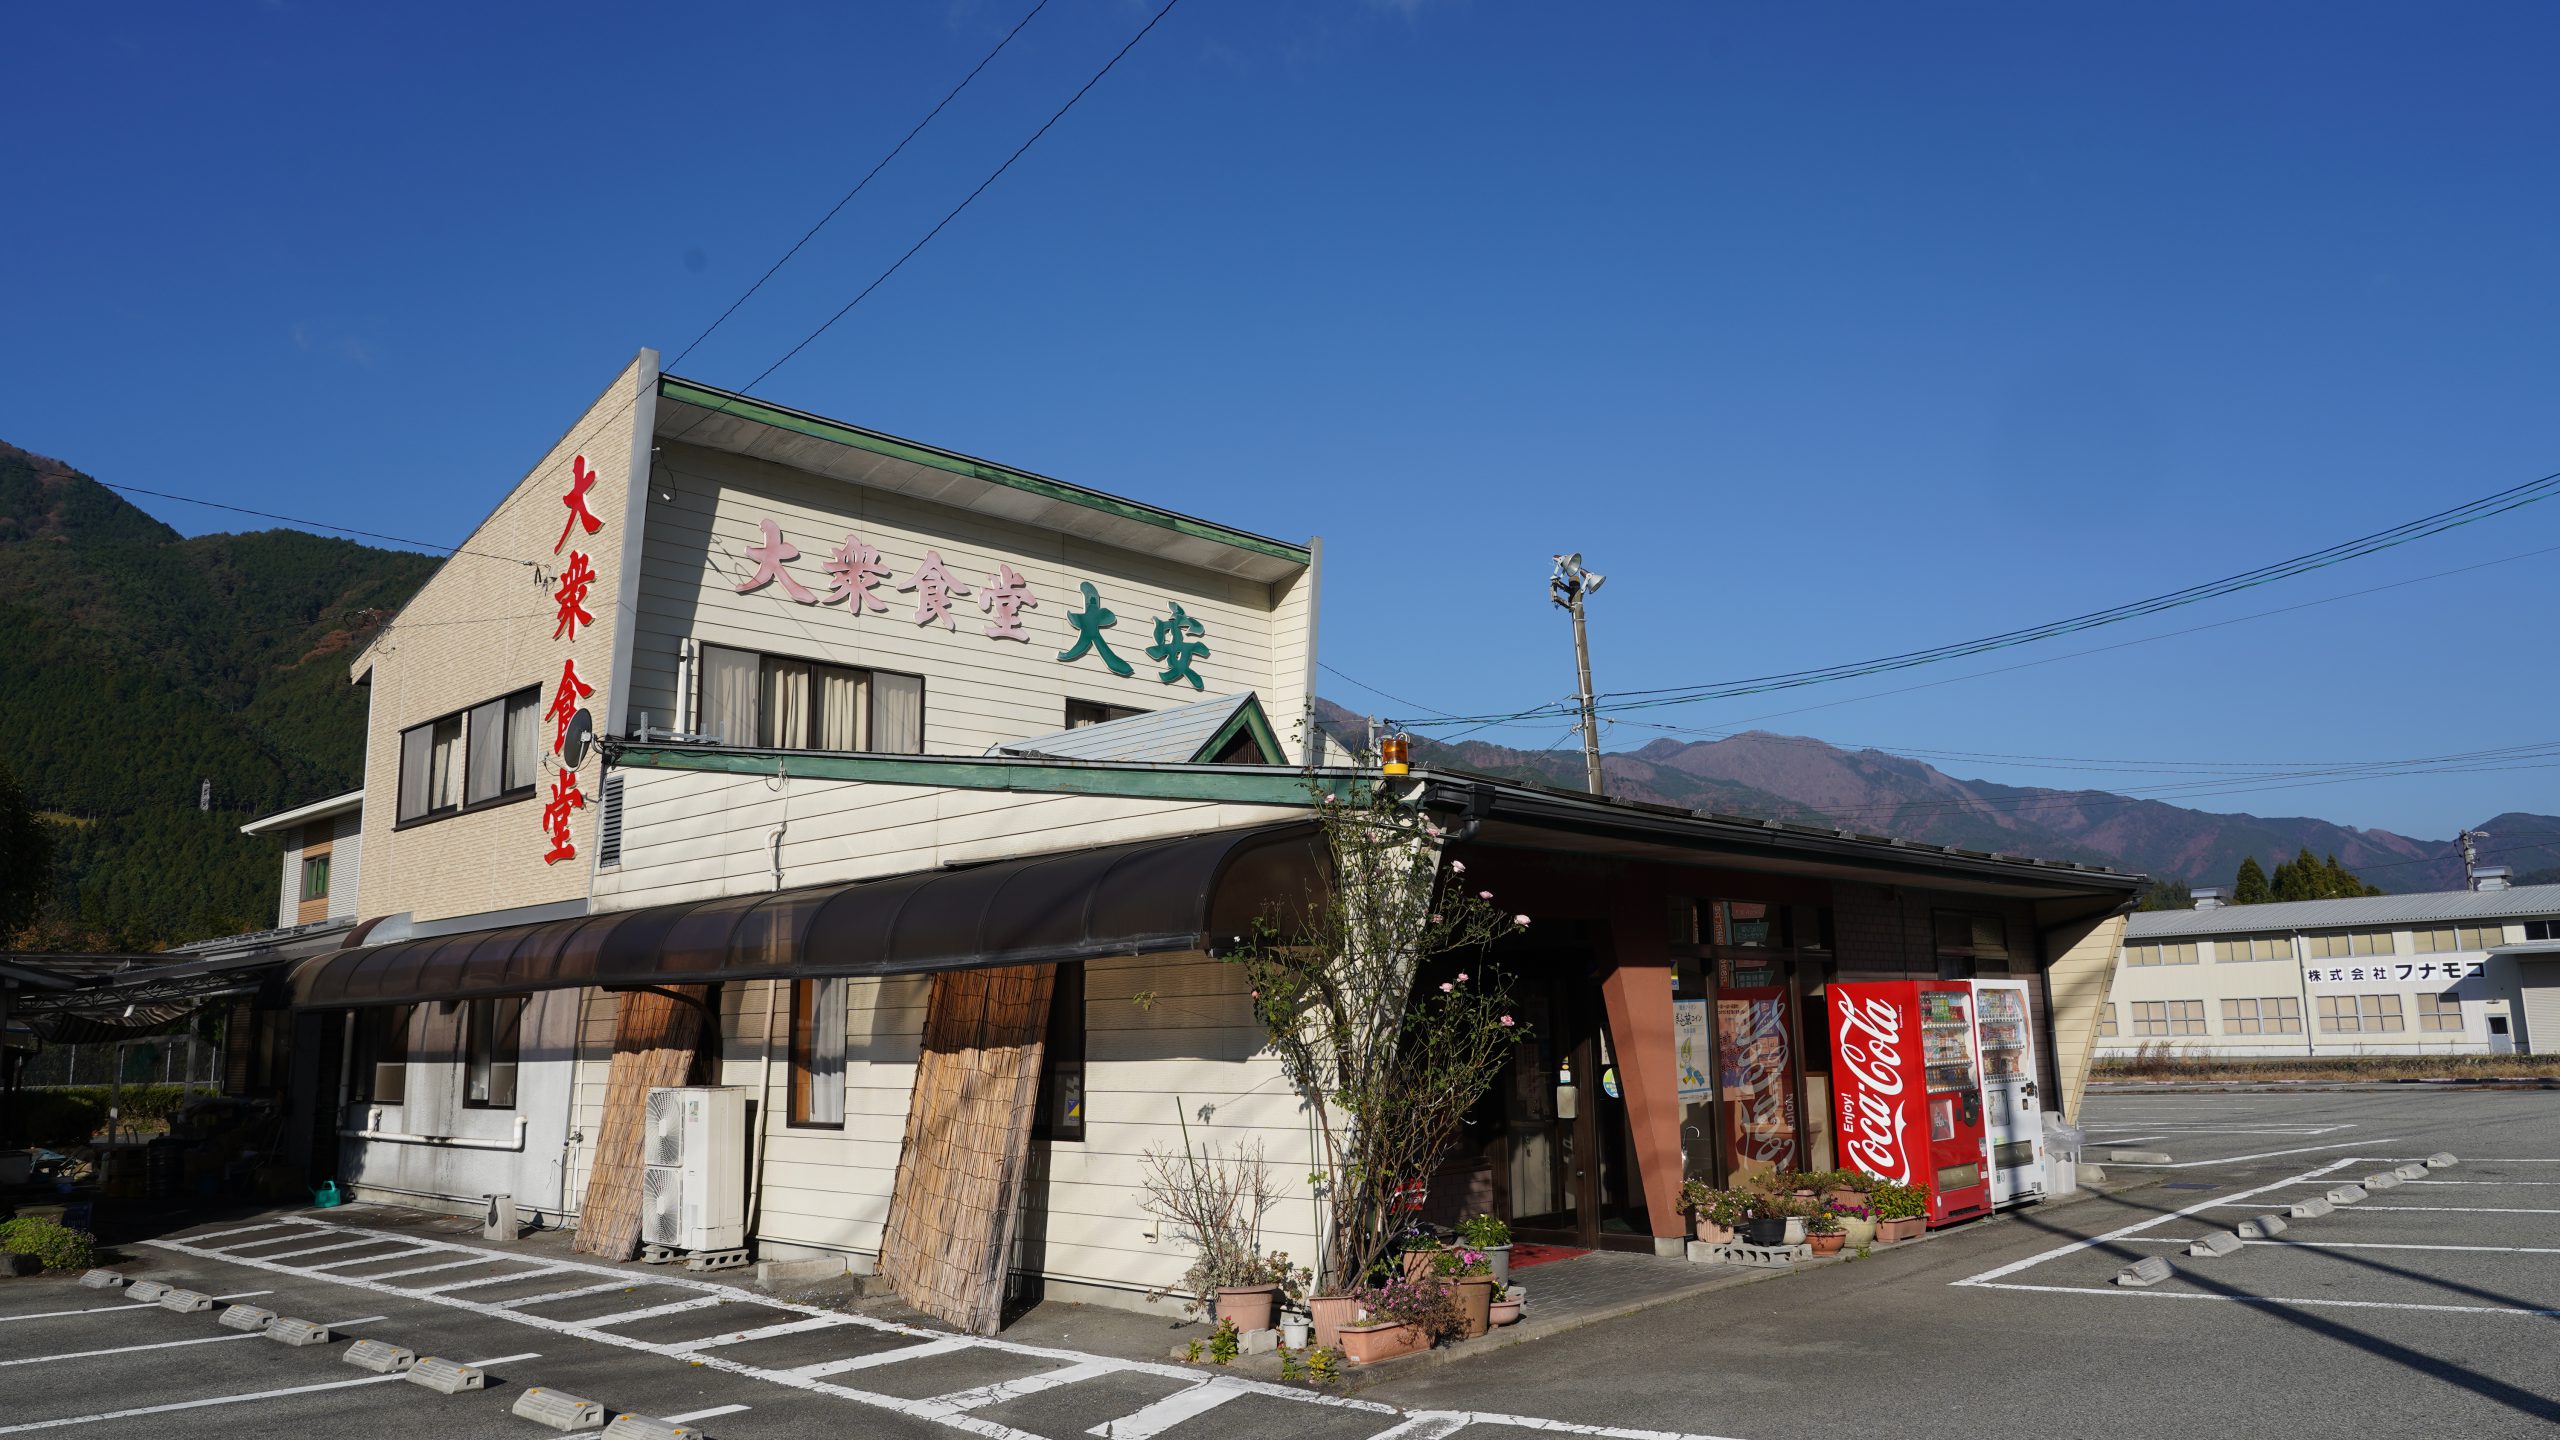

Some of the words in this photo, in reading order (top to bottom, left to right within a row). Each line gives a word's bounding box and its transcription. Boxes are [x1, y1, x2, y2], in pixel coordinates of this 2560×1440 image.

[734, 518, 1038, 642] 大衆食堂
[1057, 582, 1211, 691] 大安
[542, 455, 603, 866] 大衆食堂
[2308, 962, 2485, 982] 株式会社フナモコ
[1843, 1092, 1855, 1133] Enjoy!
